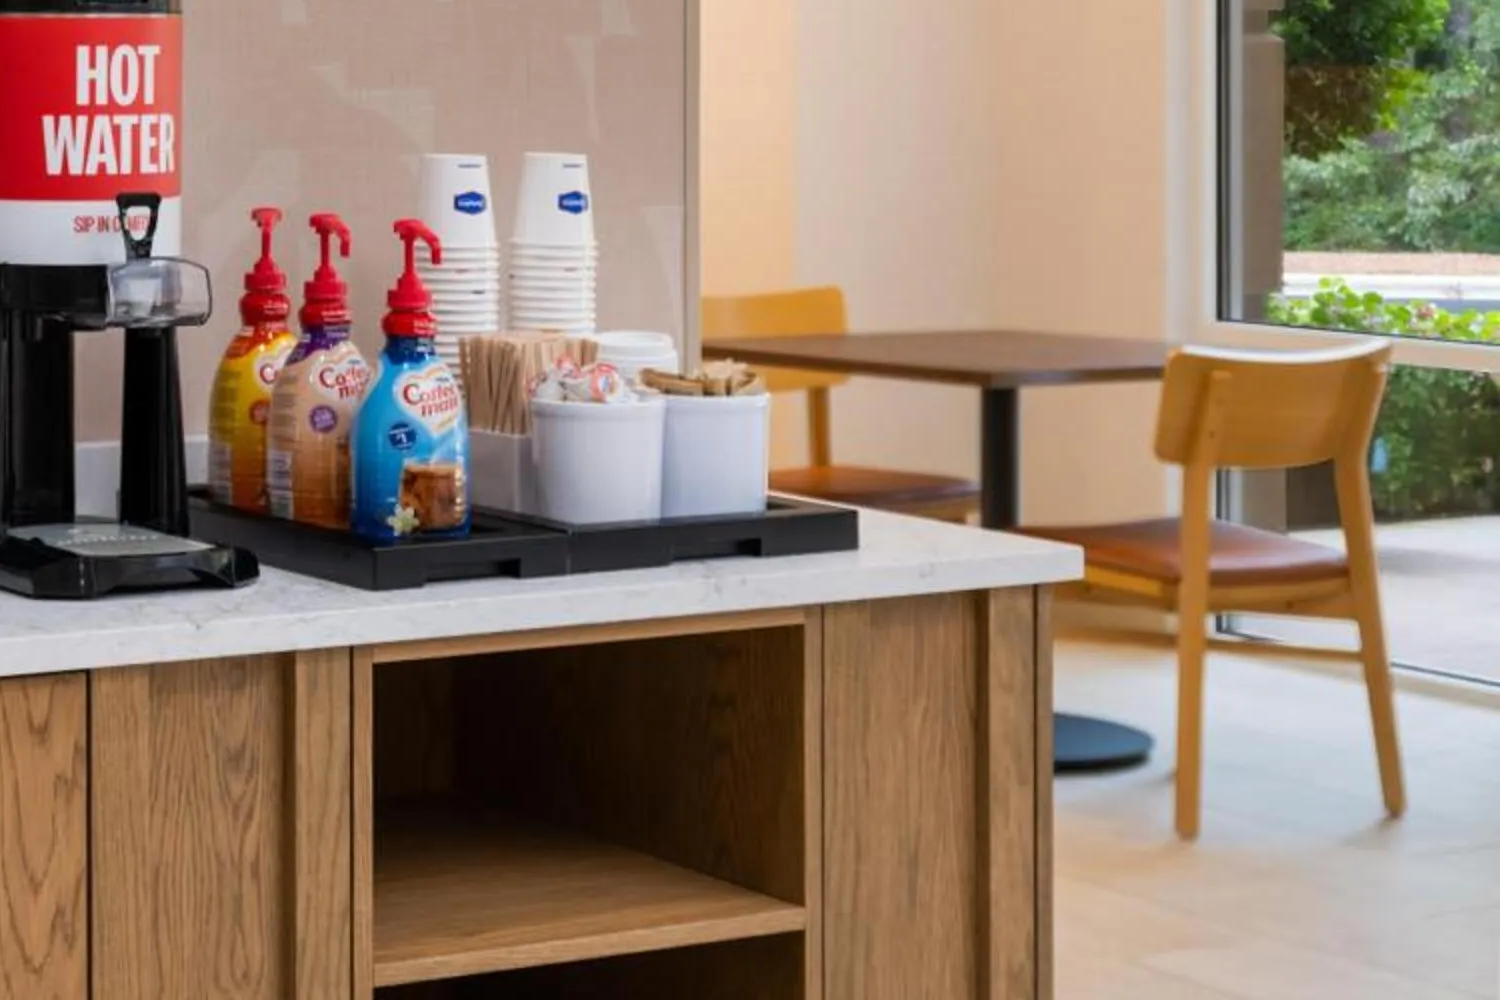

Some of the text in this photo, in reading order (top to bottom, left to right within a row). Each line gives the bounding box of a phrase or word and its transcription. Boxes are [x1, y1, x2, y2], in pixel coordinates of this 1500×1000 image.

[76, 44, 161, 106] HOT
[42, 113, 175, 176] WATER
[73, 214, 95, 233] SIP
